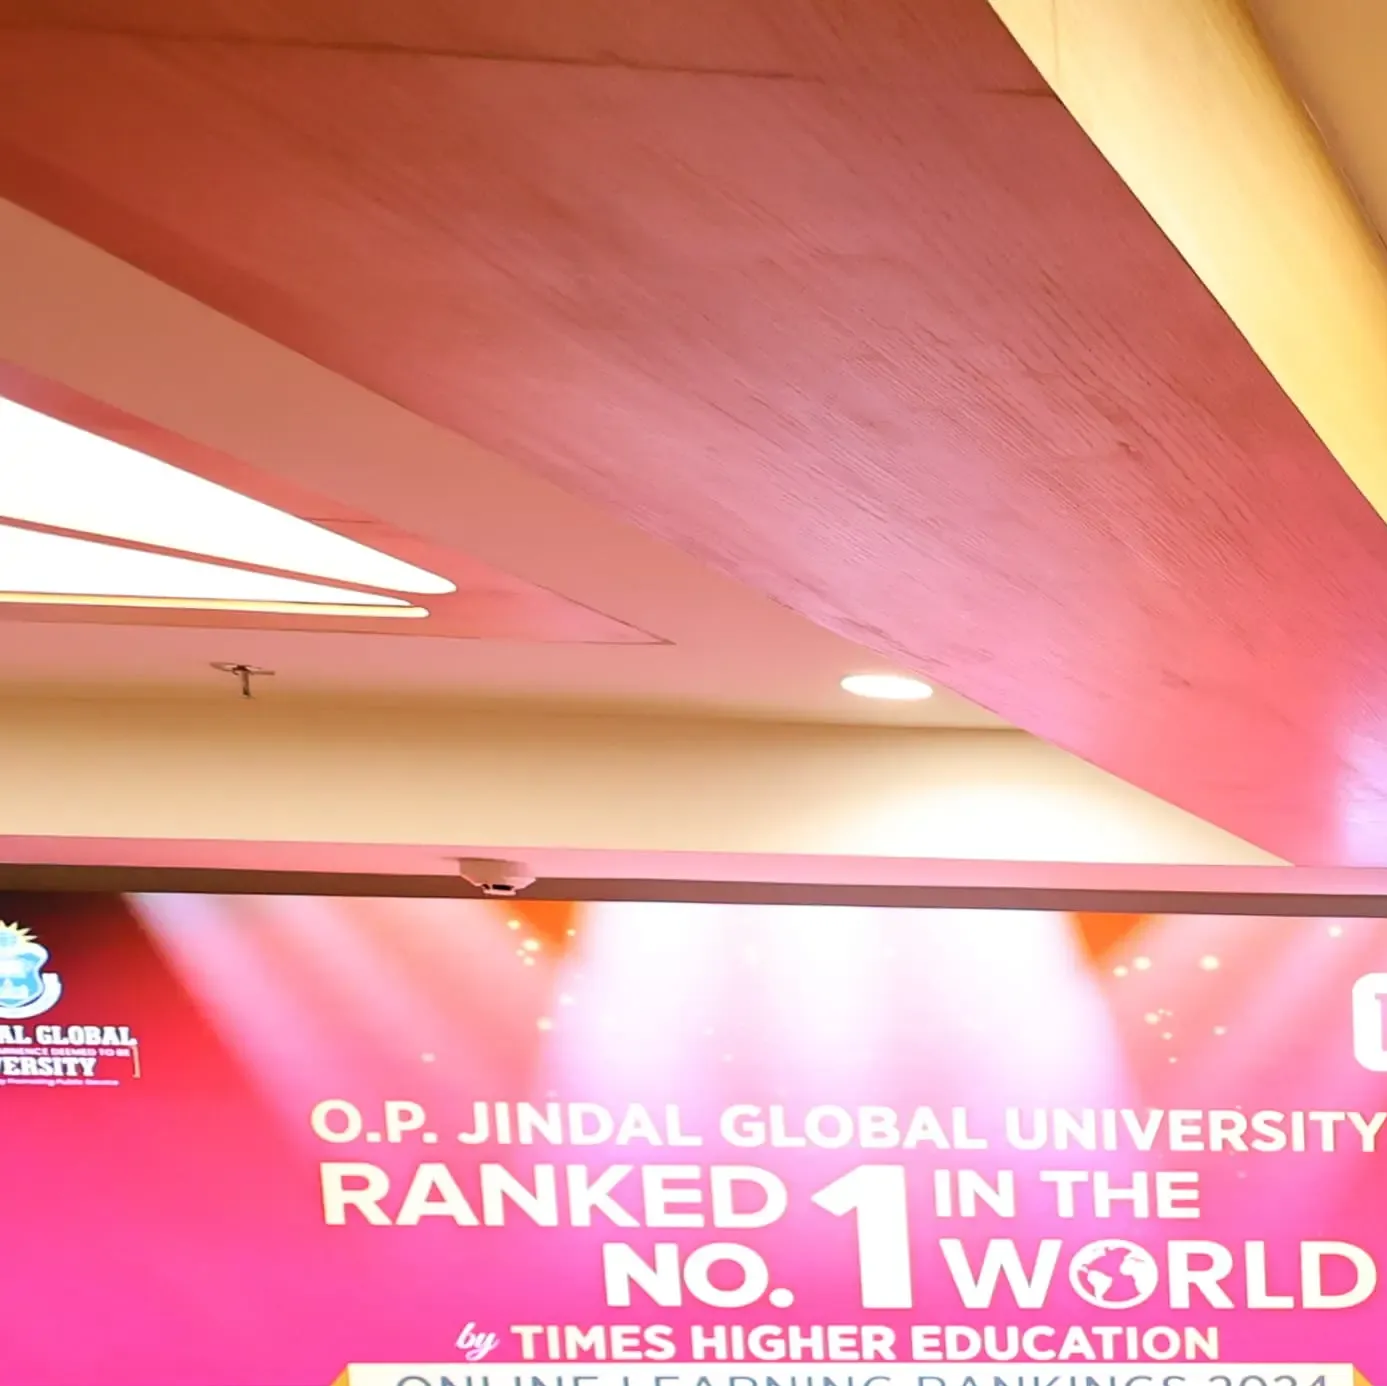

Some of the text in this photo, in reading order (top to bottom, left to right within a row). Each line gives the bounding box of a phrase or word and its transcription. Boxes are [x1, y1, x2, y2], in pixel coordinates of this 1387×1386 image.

[36, 1025, 138, 1046] GLOBAL
[0, 1057, 96, 1077] ERSITY
[312, 1100, 1387, 1152] O.P. JINDAL GLOBAL UNIVERSITY
[321, 1163, 1200, 1308] RANKED 1 IN THE
[604, 1243, 793, 1307] NO.
[456, 1322, 1218, 1360] by TIMES HIGHER EDUCATION
